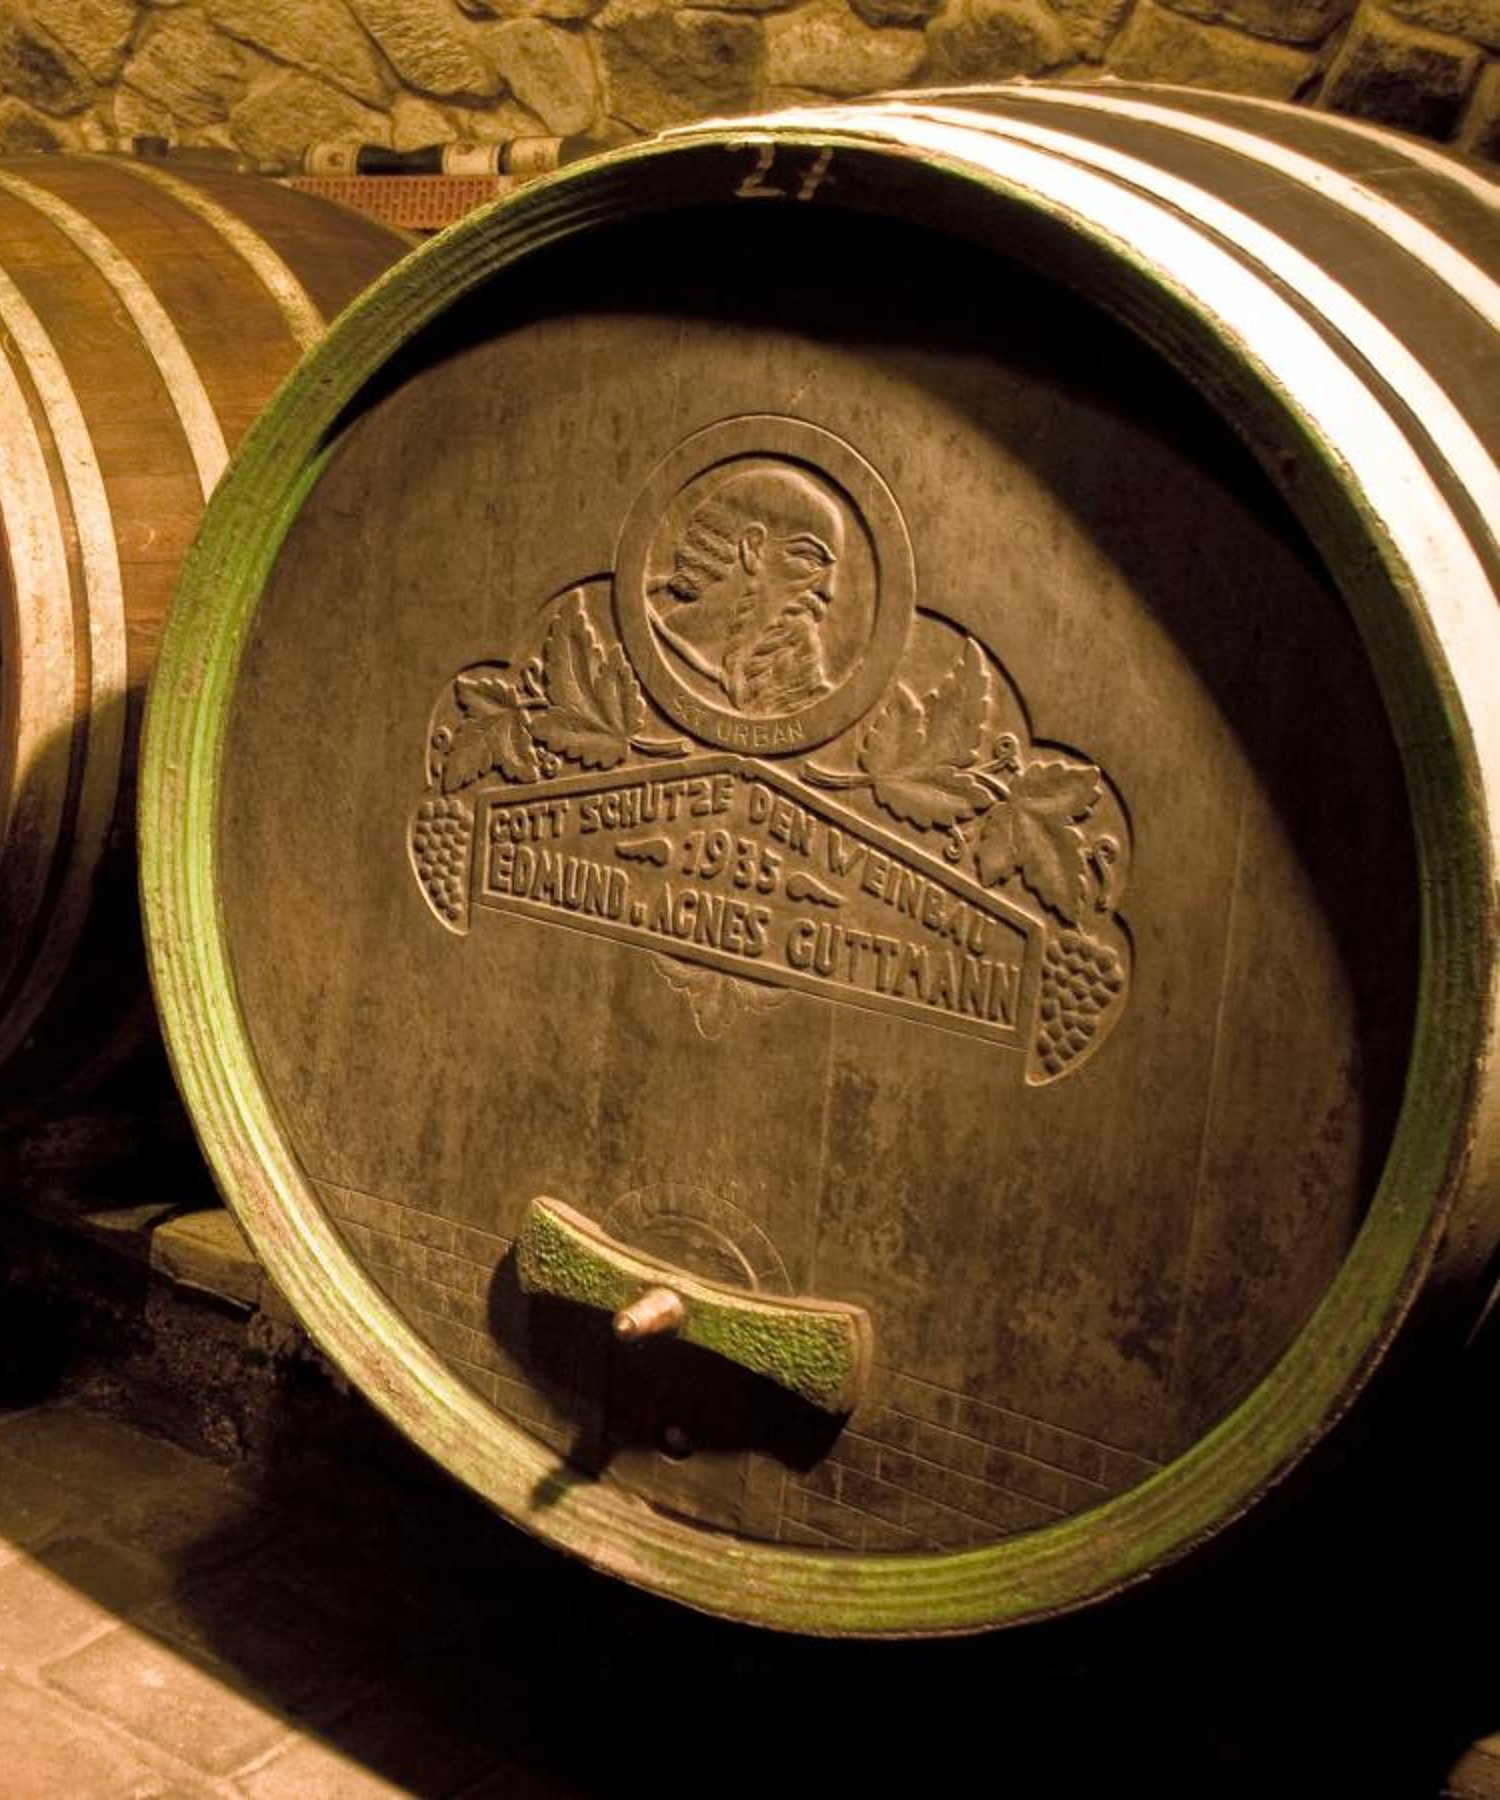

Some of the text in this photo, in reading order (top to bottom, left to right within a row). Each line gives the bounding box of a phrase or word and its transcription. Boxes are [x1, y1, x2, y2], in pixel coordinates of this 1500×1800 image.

[716, 720, 805, 748] URBAN
[490, 798, 571, 844] GOTT
[748, 782, 817, 857] DEN
[826, 826, 998, 958] WEINBAU
[680, 828, 784, 896] 1935
[490, 842, 630, 921] EDMUND
[650, 880, 773, 958] AGNES
[785, 916, 1021, 1030] GUTTMANN
